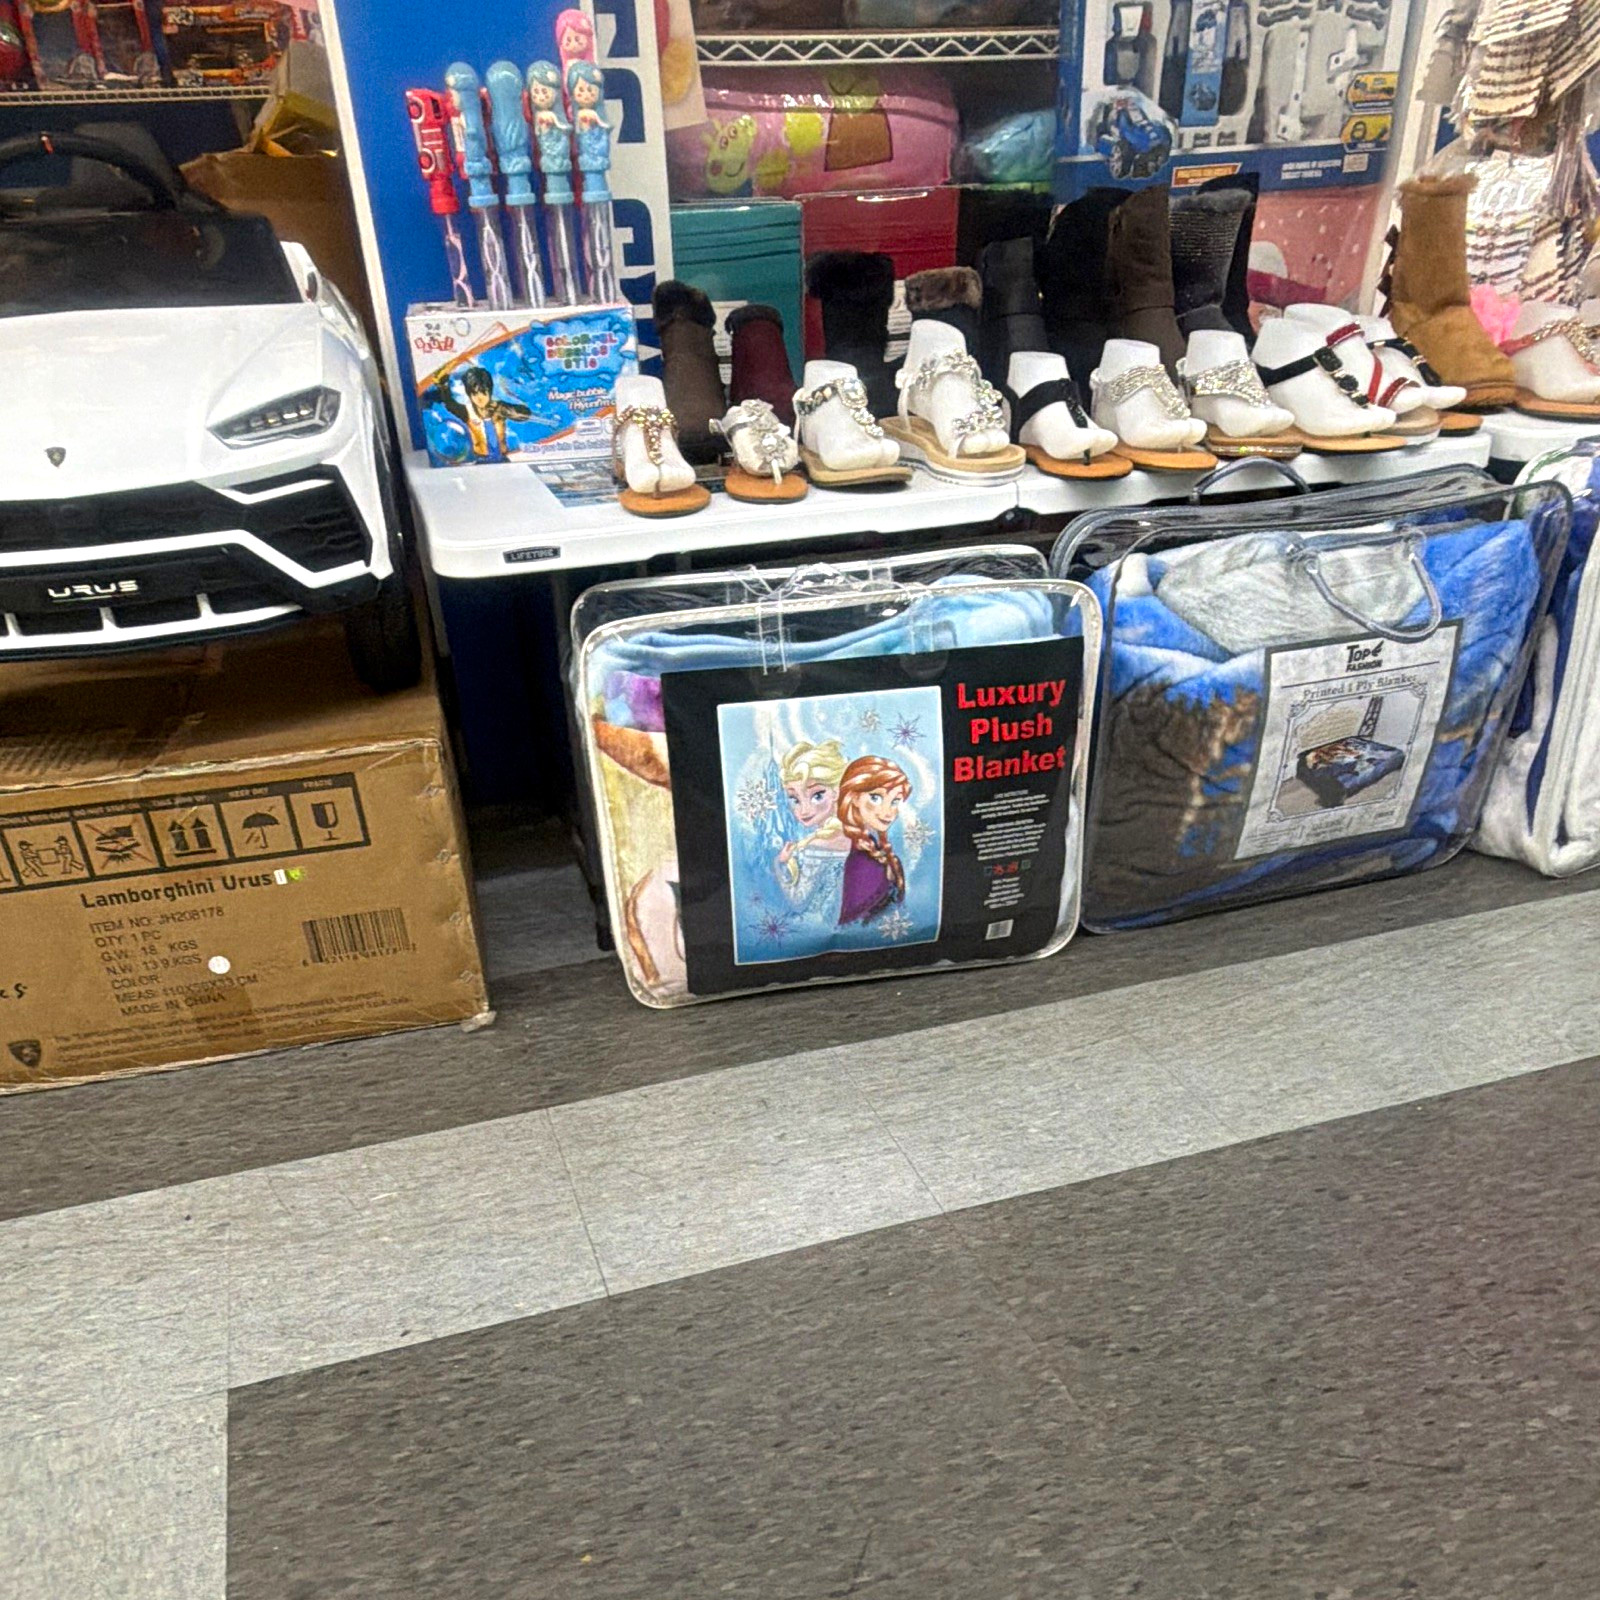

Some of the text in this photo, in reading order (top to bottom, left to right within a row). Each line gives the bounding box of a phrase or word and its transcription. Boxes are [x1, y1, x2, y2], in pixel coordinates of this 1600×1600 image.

[511, 549, 554, 560] LIFETIME
[47, 580, 138, 598] URUS
[1345, 659, 1383, 672] FASHION
[957, 680, 1066, 709] Luxury
[1303, 682, 1344, 699] Printed
[1376, 673, 1419, 688] Blanket
[970, 712, 1052, 744] Plush
[954, 745, 1066, 782] Blanket
[80, 873, 273, 909] Lamborghini Urus
[89, 920, 124, 934] ITEM
[141, 930, 162, 942] PC
[168, 939, 199, 952] KGS
[120, 992, 227, 1016] MADE IN CHINA
